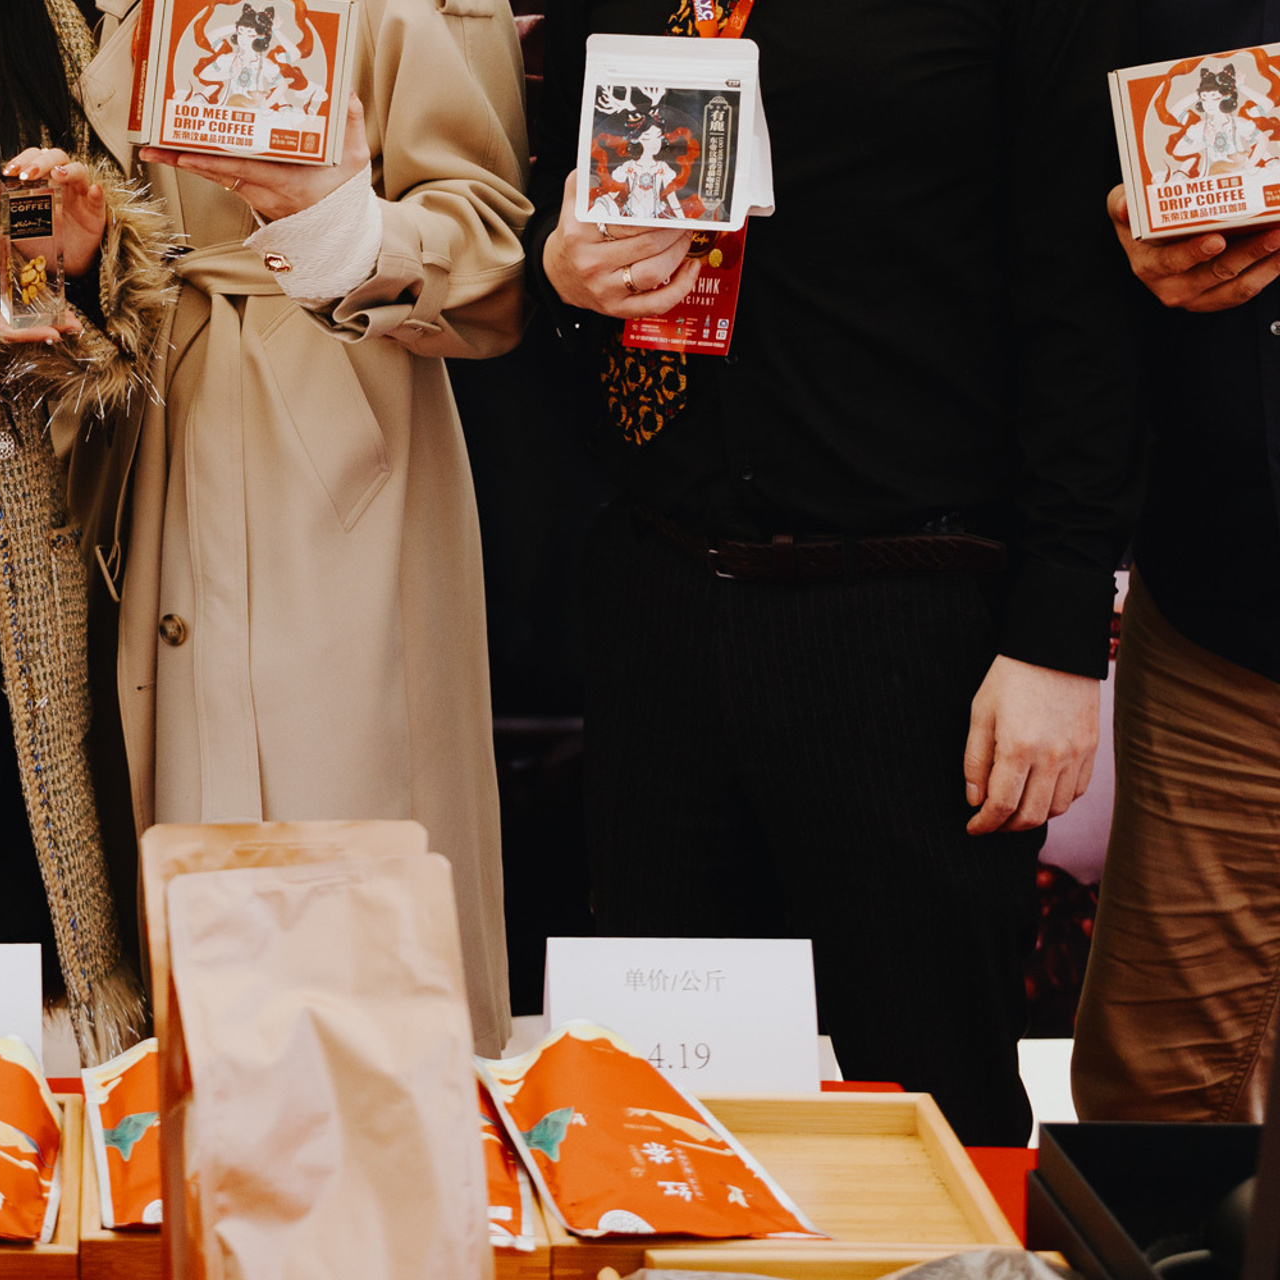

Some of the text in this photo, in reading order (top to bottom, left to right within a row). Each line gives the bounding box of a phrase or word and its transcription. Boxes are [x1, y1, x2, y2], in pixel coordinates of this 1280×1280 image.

[175, 104, 199, 117] LOO
[203, 107, 228, 120] MEE
[174, 117, 254, 136] DRIP COFFEE
[1157, 185, 1182, 198] LOO
[1187, 180, 1214, 194] MEE
[10, 203, 51, 213] COFFEE
[1159, 189, 1245, 212] DRIP COFFEE
[624, 968, 726, 992] 单价/公斤
